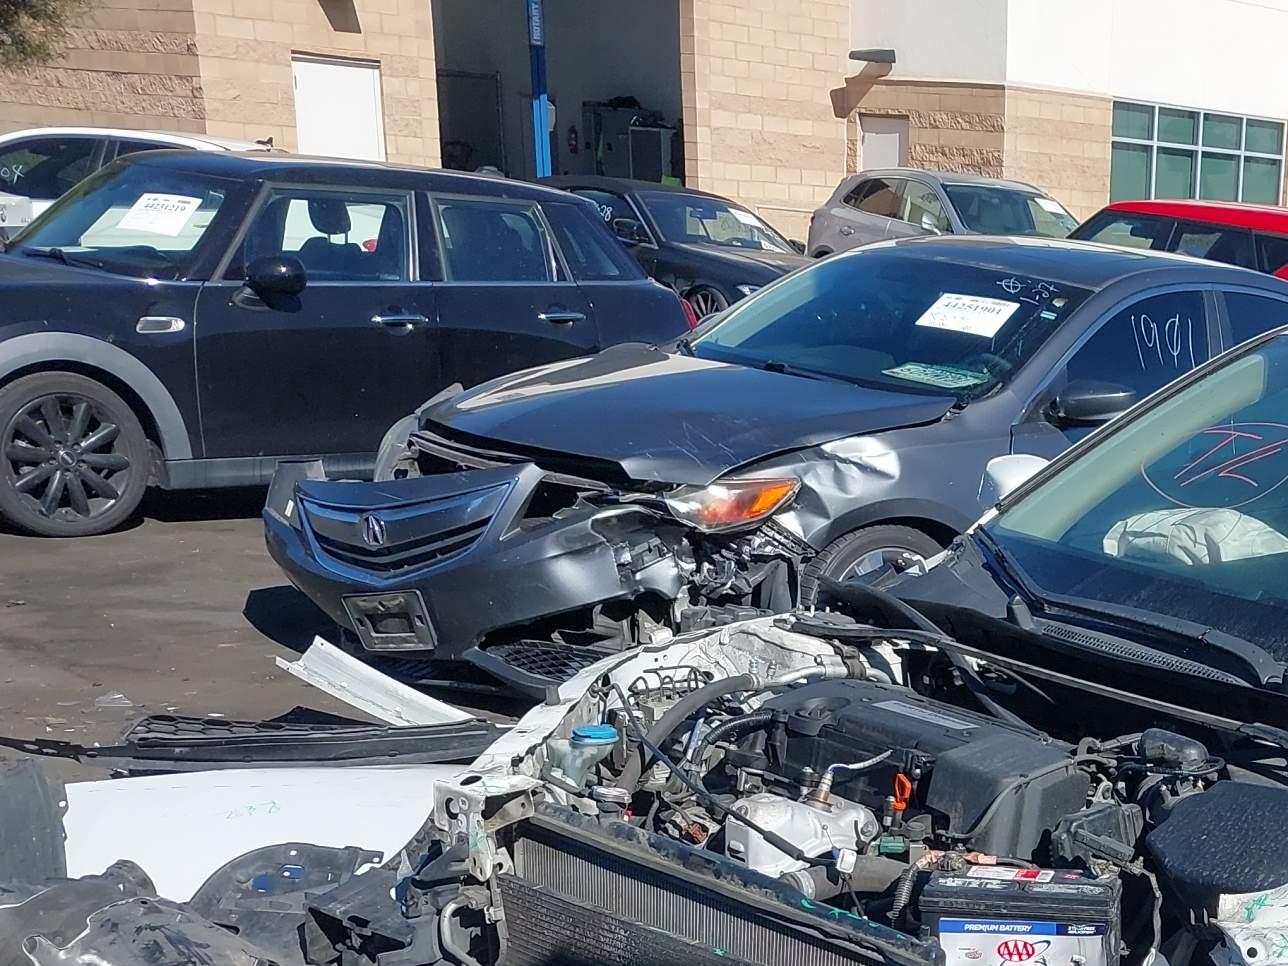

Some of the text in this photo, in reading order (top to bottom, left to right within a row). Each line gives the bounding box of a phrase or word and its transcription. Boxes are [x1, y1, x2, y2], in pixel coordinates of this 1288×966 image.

[963, 923, 1033, 932] PREMIUM BATTERY
[998, 941, 1034, 962] AAA
